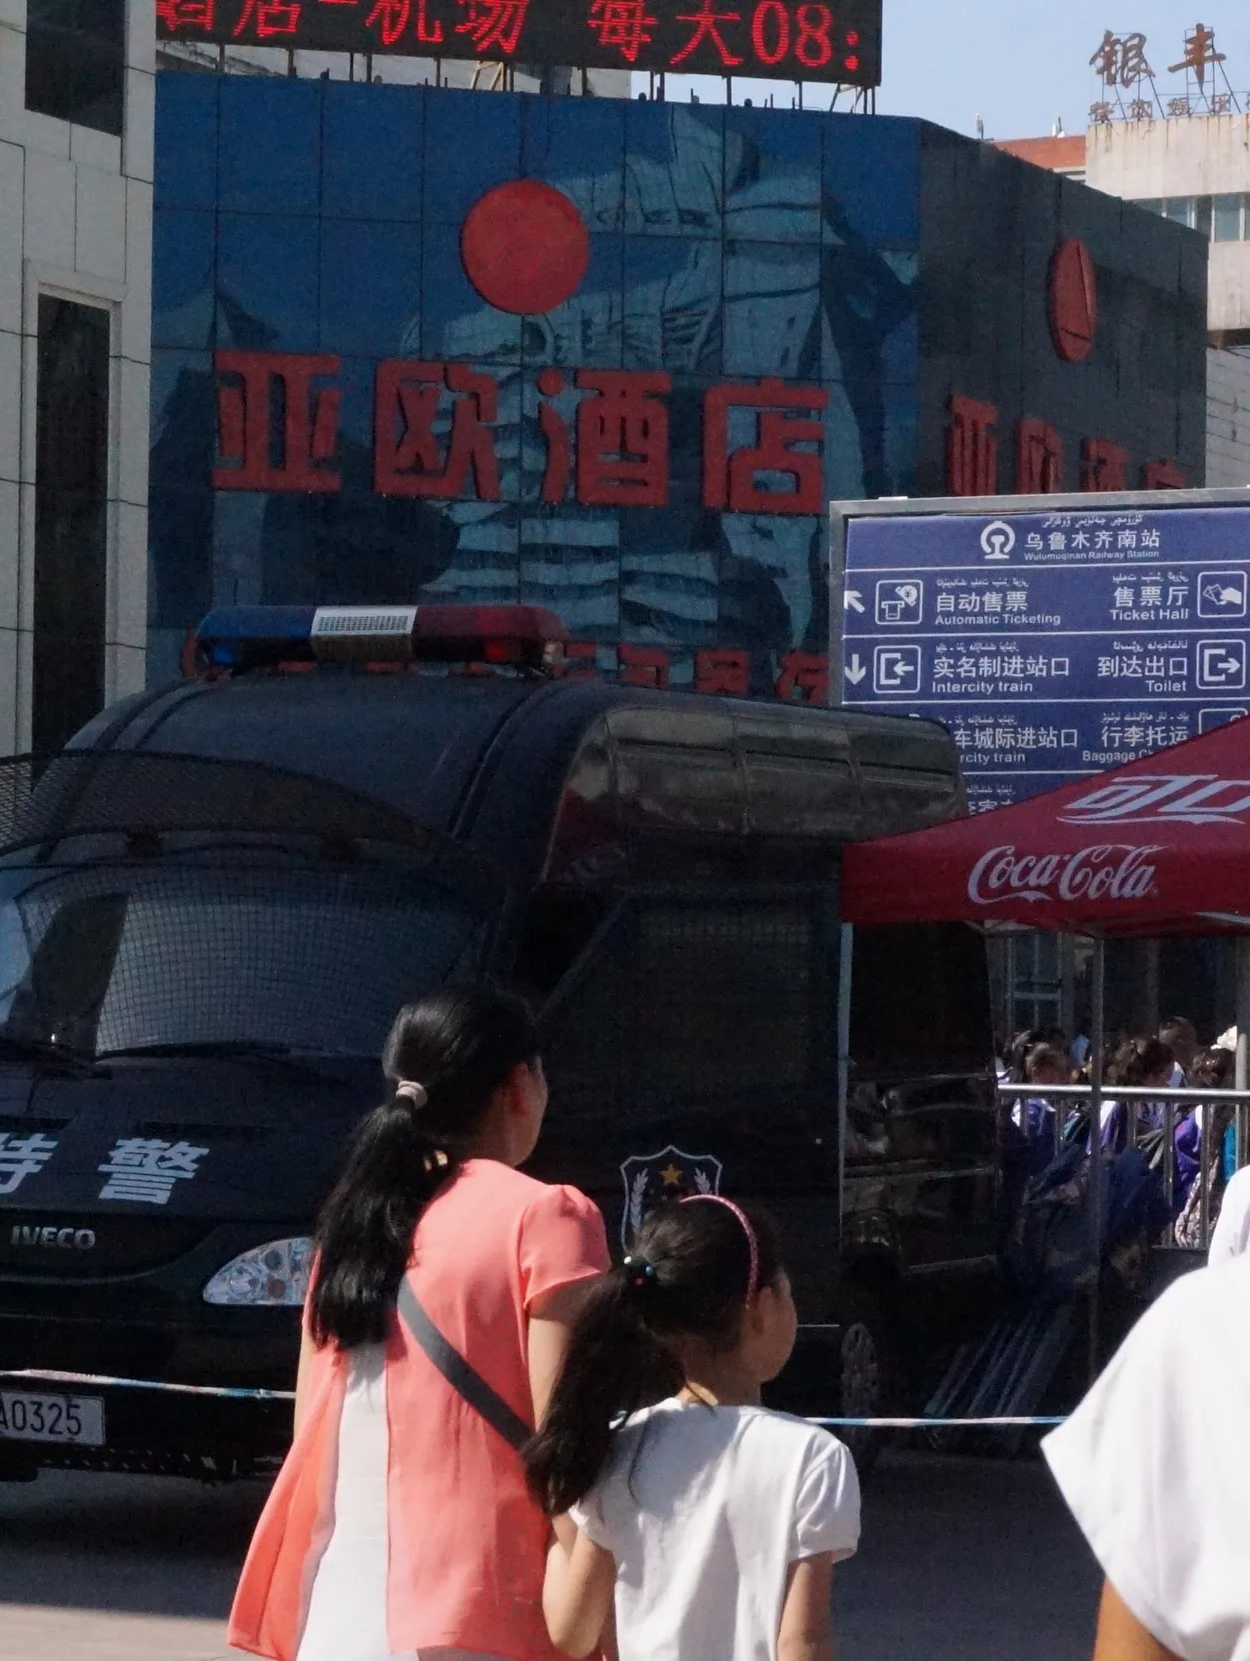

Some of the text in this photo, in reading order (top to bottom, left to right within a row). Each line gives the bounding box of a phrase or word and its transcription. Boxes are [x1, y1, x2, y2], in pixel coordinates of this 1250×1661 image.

[211, 349, 830, 514] 亚欧酒店
[1024, 528, 1161, 553] 乌鲁木齐南站
[1088, 551, 1125, 560] Railway
[1127, 549, 1160, 559] Station
[936, 590, 1029, 613] 自动售票
[1113, 585, 1190, 608] 售票厅
[935, 613, 1061, 625] Automatic Ticketing
[1110, 608, 1189, 621] Ticket Hall
[933, 655, 1069, 678] 实名制进站口
[1097, 655, 1188, 677] 到达出口
[932, 680, 1033, 694] Intercity train
[1145, 680, 1187, 692] Toilet
[1101, 724, 1190, 748] 行李托运
[993, 751, 1026, 763] train
[1082, 749, 1137, 764] Baggage
[10, 1225, 96, 1250] IVECO
